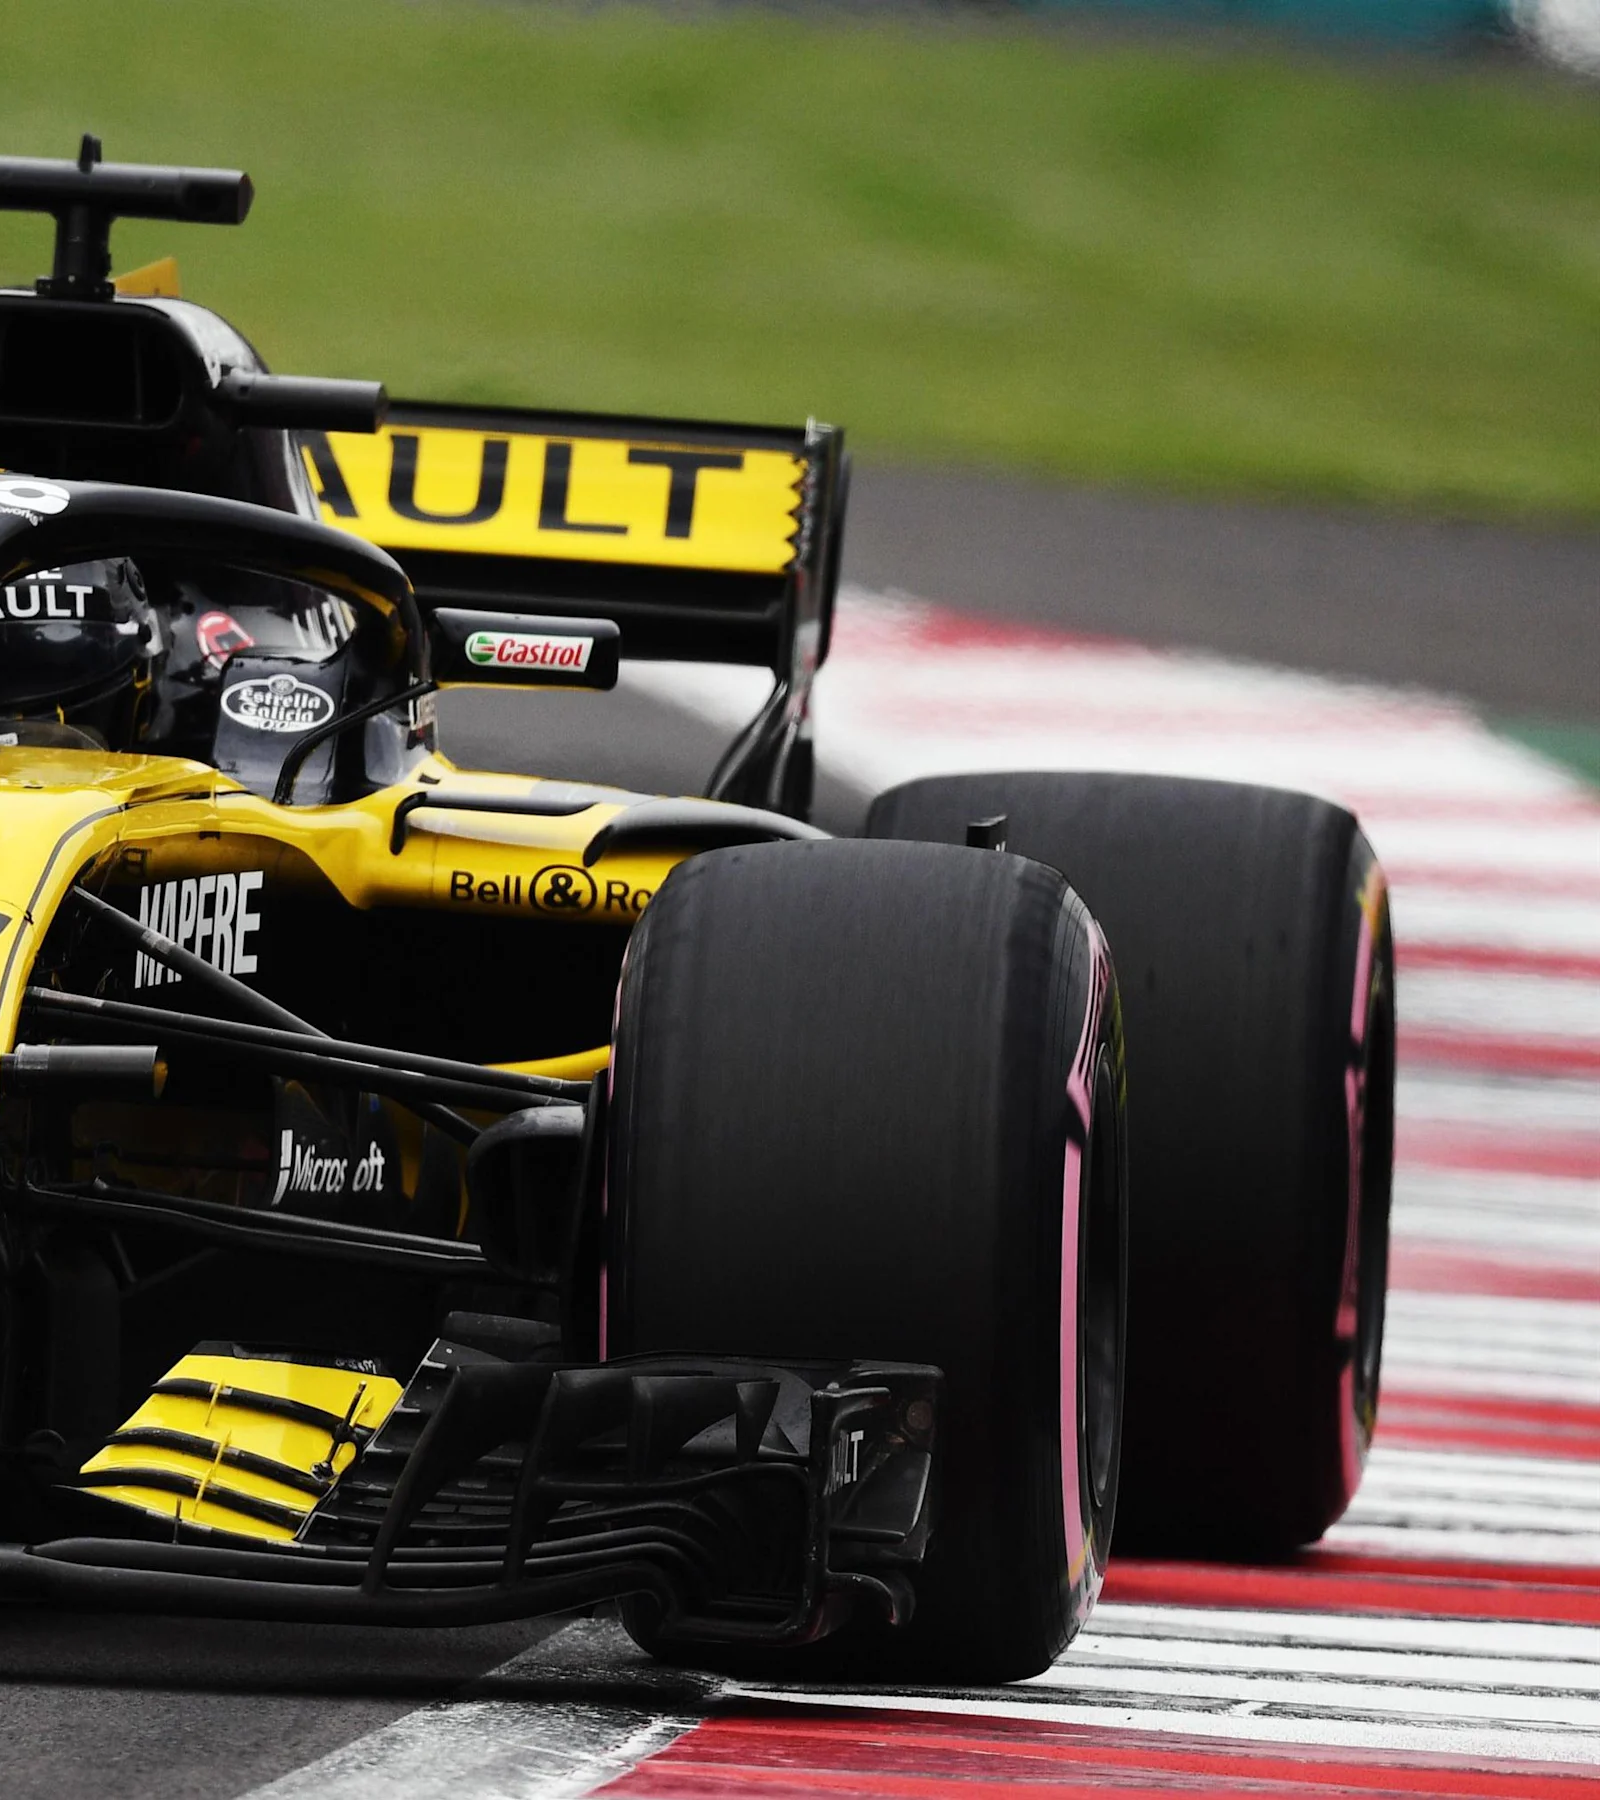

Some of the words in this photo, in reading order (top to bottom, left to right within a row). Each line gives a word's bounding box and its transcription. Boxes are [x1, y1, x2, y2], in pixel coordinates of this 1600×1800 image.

[496, 638, 585, 667] Castrol
[238, 686, 321, 709] Estrella
[239, 702, 314, 723] Galicia
[450, 870, 521, 905] Bell
[543, 872, 584, 909] &
[603, 880, 653, 912] Ro
[134, 870, 264, 989] MAPFRE
